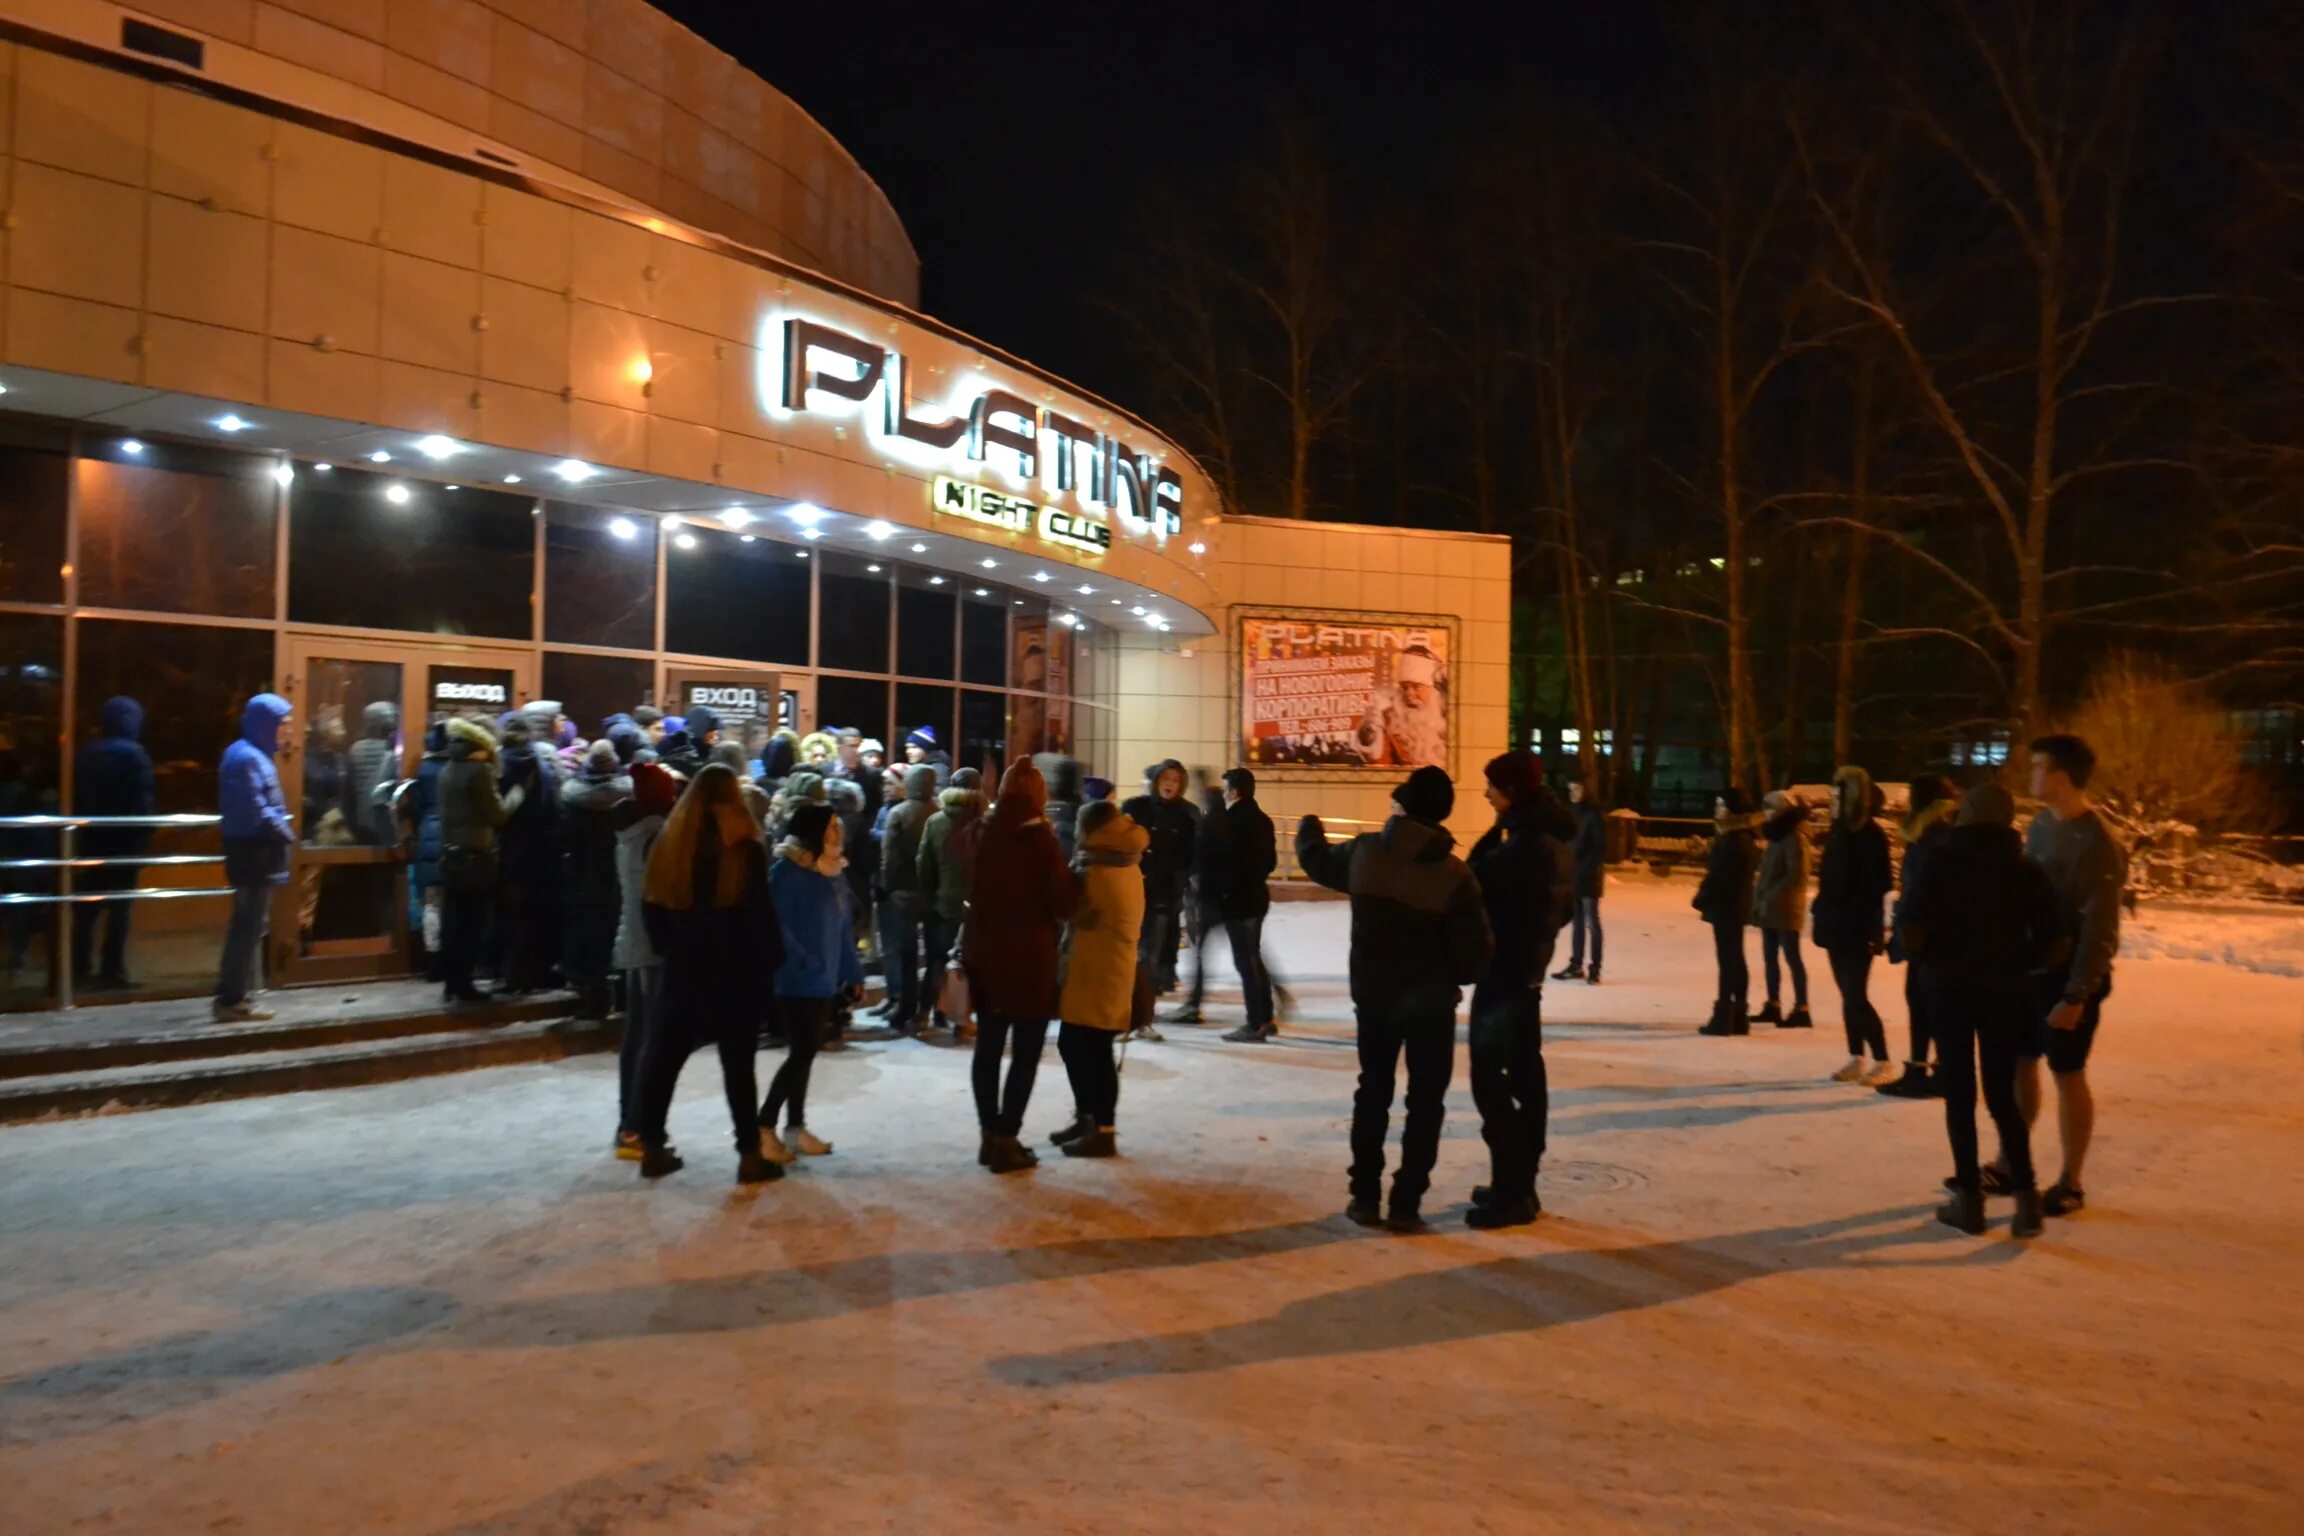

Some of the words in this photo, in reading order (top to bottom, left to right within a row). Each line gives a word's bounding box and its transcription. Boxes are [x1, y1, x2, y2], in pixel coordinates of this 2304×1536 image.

[781, 317, 1183, 535] PLATINA
[945, 481, 1040, 530] NIGHT
[1261, 623, 1430, 648] PLATINA
[435, 682, 506, 703] ВЫХОД
[689, 687, 758, 708] ВХОД
[1256, 678, 1278, 697] НА
